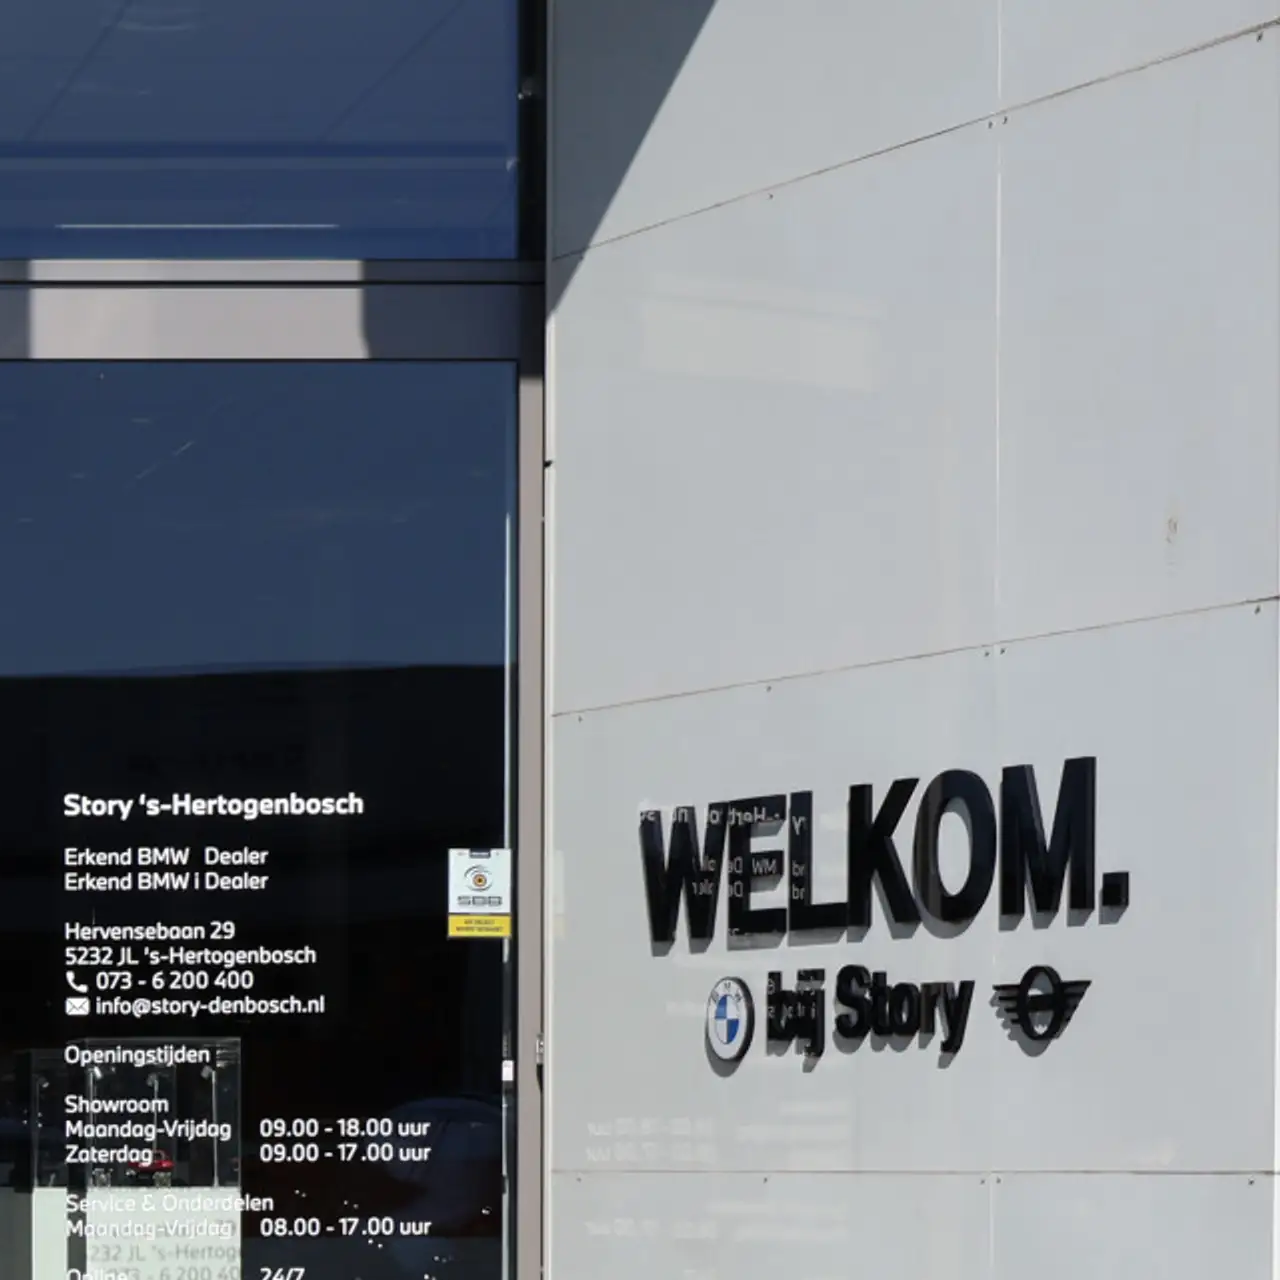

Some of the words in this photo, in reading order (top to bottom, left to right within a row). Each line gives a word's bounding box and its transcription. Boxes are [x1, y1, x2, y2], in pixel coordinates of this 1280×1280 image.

[64, 795, 133, 821] Story
[65, 848, 132, 865] Erkend
[138, 847, 189, 865] BMW
[205, 847, 268, 865] Dealer
[639, 755, 1129, 946] WELKOM.
[65, 872, 132, 890] Erkend
[138, 872, 190, 890] BMW
[194, 872, 200, 890] i
[205, 872, 268, 890] Dealer
[65, 922, 205, 940] Hervensebaan
[210, 921, 235, 939] 29
[66, 947, 113, 965] 5232
[117, 947, 139, 966] JL
[144, 946, 316, 968] 's-Hertogenbosch
[96, 971, 132, 989] 073
[152, 971, 165, 989] 6
[170, 971, 208, 989] 200
[214, 970, 253, 989] 400
[96, 995, 325, 1017] info@story-denbosch.nl
[767, 966, 824, 1058] bij
[835, 964, 975, 1054] Story
[65, 1046, 210, 1067] Openingstijden
[65, 1095, 169, 1113] Showroom
[65, 1120, 231, 1142] Maandag-Vrijdag
[260, 1118, 319, 1137] 09.00
[337, 1118, 393, 1137] 18.00
[398, 1122, 430, 1137] uur
[65, 1145, 153, 1164] Zaterdag
[260, 1143, 319, 1162] 09.00
[398, 1147, 431, 1162] uur
[66, 1194, 135, 1213] Service
[141, 1194, 155, 1213] &
[162, 1194, 273, 1213] Onderdelen
[66, 1219, 233, 1240] Maandag-Vrijdag
[260, 1218, 320, 1237] 08.00
[400, 1221, 432, 1236] uur
[87, 1245, 122, 1261] 232
